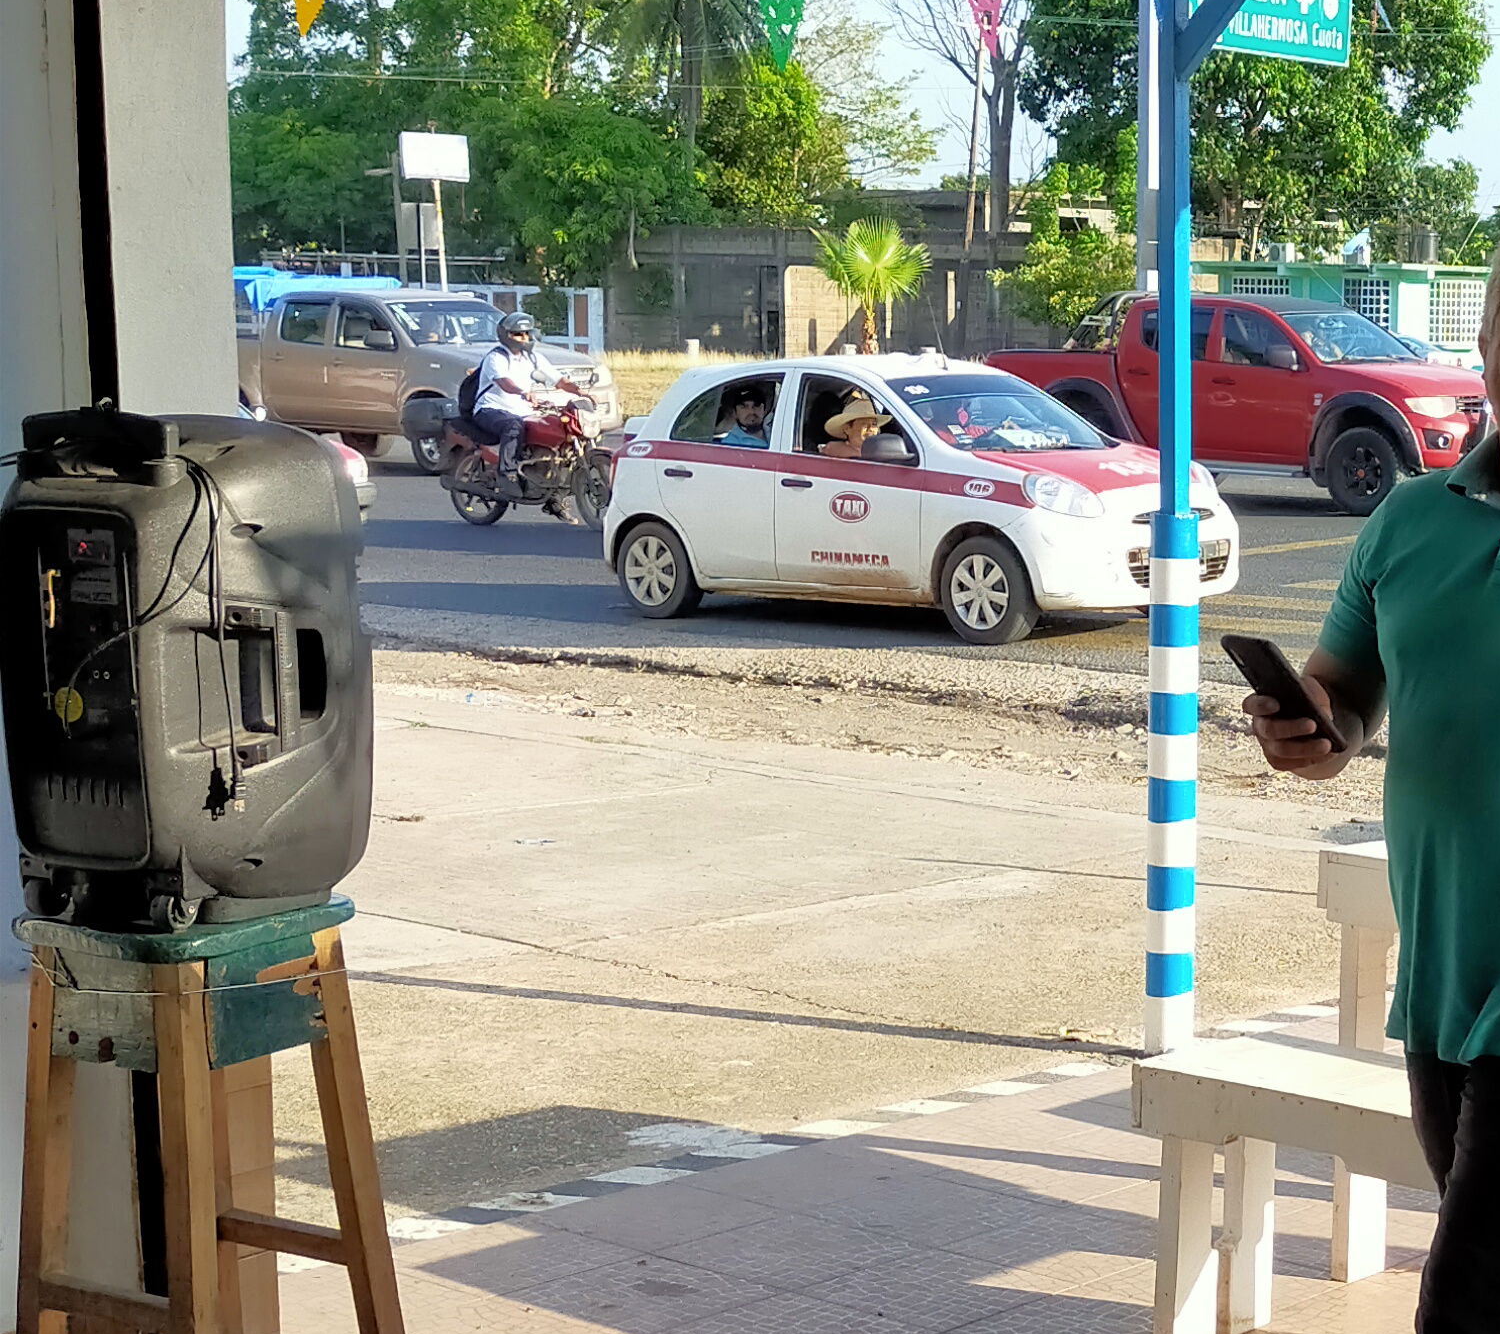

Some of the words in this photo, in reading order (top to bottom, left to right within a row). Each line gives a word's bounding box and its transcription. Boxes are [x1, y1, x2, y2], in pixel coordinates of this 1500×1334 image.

[1229, 11, 1308, 45] VILLAHERMOSA
[1312, 22, 1343, 51] Cuota
[834, 498, 865, 517] TAXI
[811, 550, 890, 568] CHINAMECA
